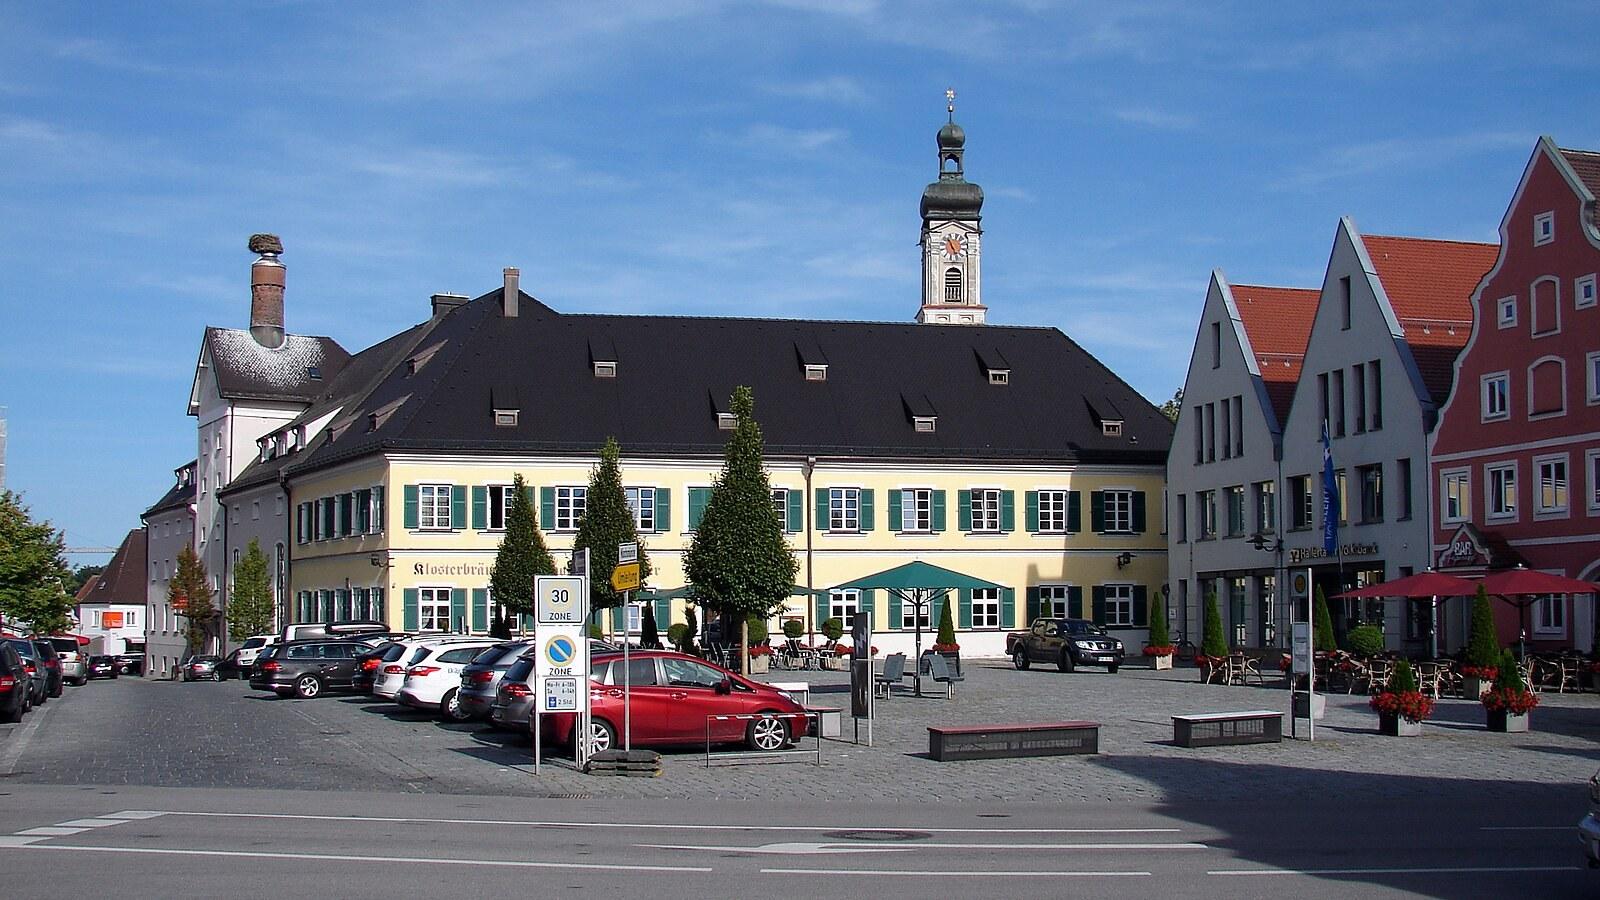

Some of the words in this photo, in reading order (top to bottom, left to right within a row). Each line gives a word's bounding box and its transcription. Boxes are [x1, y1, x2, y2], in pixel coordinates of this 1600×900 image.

[1455, 541, 1473, 555] BAR
[551, 589, 569, 603] 30
[549, 613, 572, 621] ZONE
